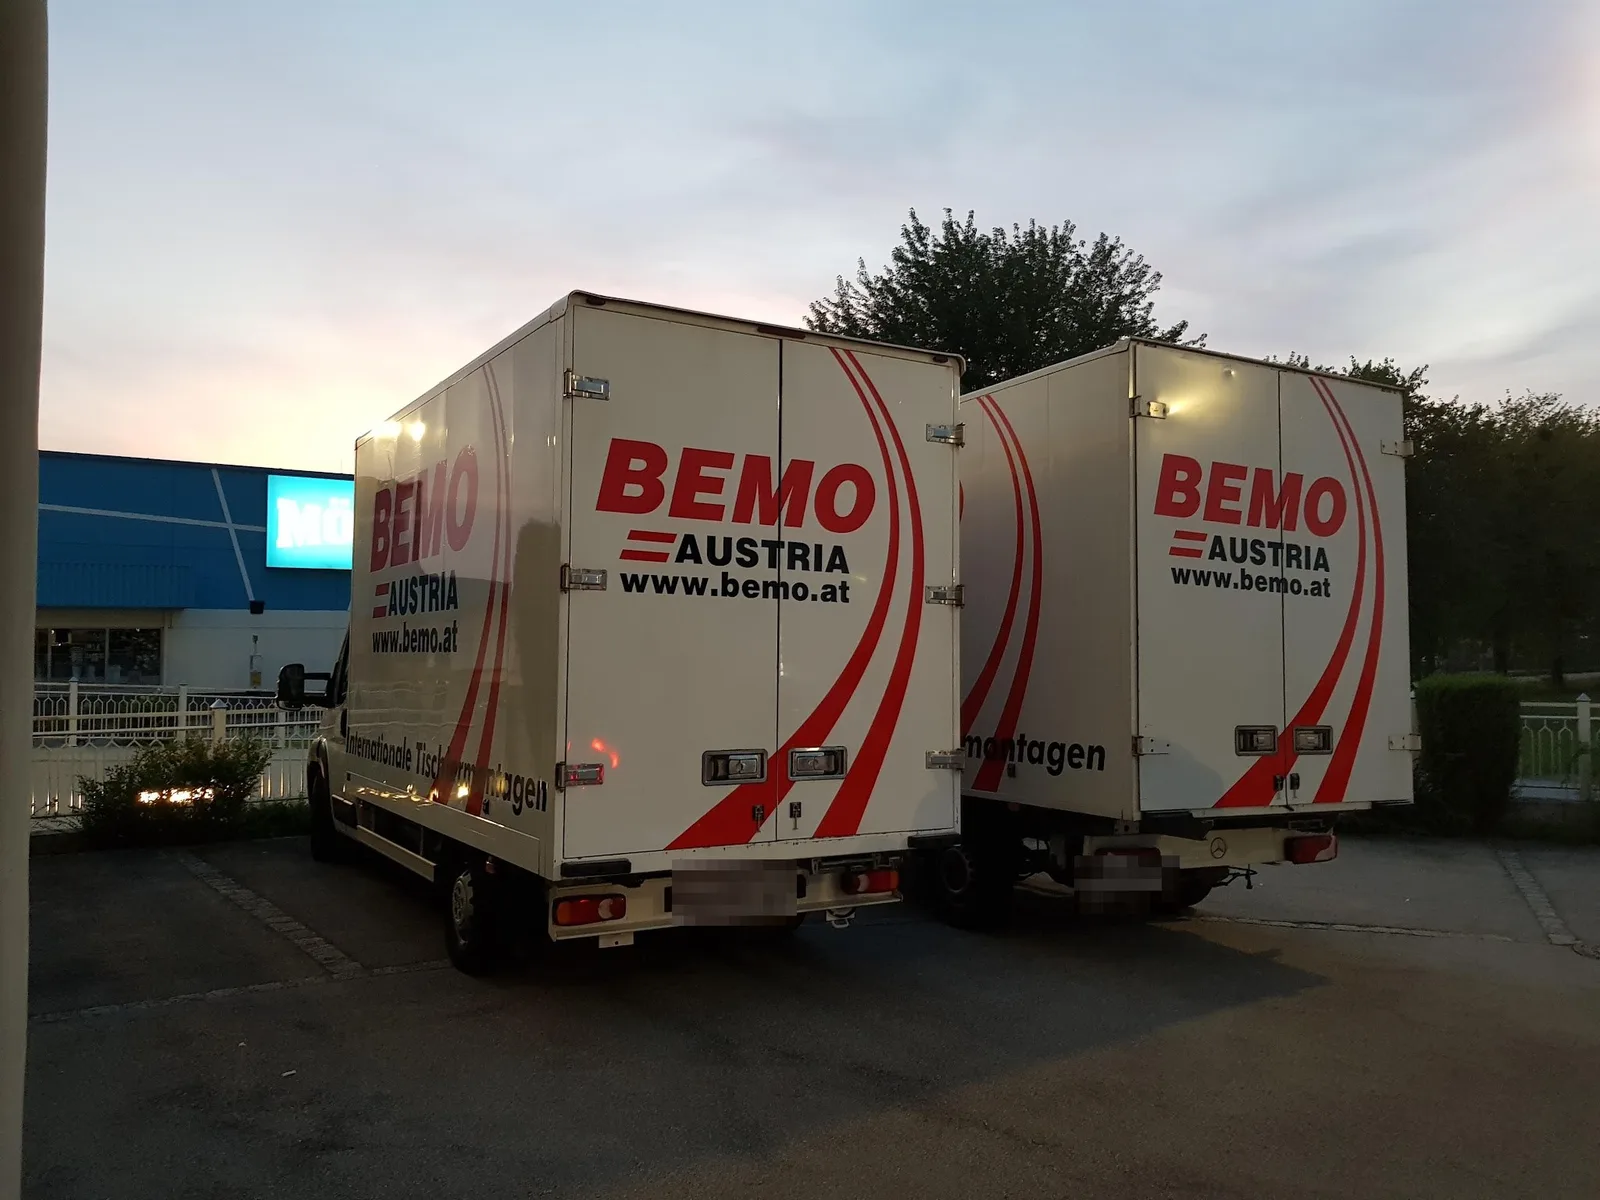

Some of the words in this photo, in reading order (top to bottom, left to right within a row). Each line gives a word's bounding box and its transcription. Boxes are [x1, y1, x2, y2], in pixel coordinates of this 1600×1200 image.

[595, 437, 876, 534] BEMO
[1153, 453, 1347, 538] BEMO
[370, 444, 479, 573] BEMO
[674, 533, 850, 574] AUSTRIA
[1207, 535, 1331, 573] AUSTRIA
[388, 570, 459, 617] AUSTRIA
[619, 571, 850, 604] www.bemo.at
[1170, 567, 1331, 598] www.bemo.at
[372, 620, 459, 653] www.bemo.at
[345, 726, 412, 771] Internationale
[415, 741, 548, 816] Tischrmntagen
